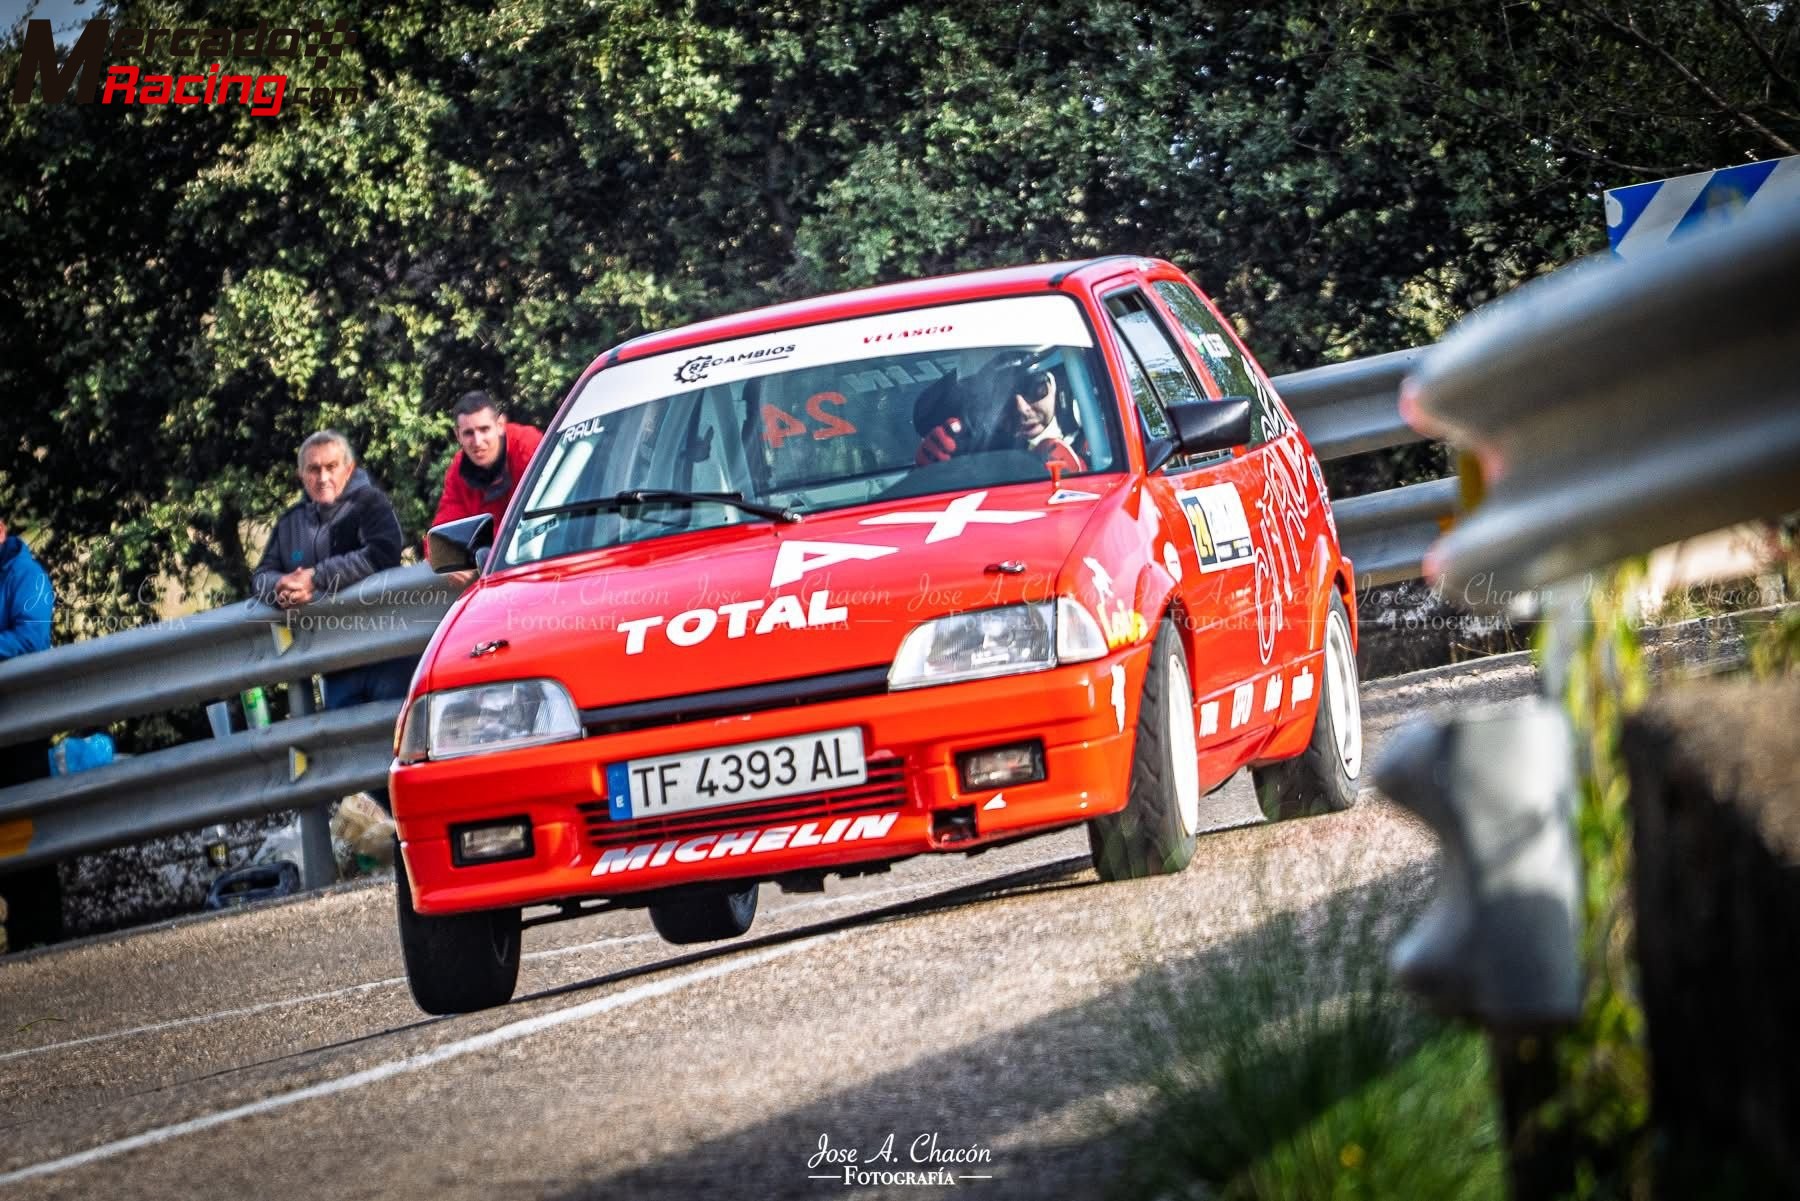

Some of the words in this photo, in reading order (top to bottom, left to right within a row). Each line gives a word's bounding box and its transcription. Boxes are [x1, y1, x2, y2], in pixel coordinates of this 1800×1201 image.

[688, 344, 796, 374] RECAMBIOS
[617, 590, 849, 656] TOTAL
[632, 762, 682, 808] TF
[696, 746, 797, 798] 4393
[810, 737, 860, 782] AL
[591, 811, 900, 877] MICHELIN
